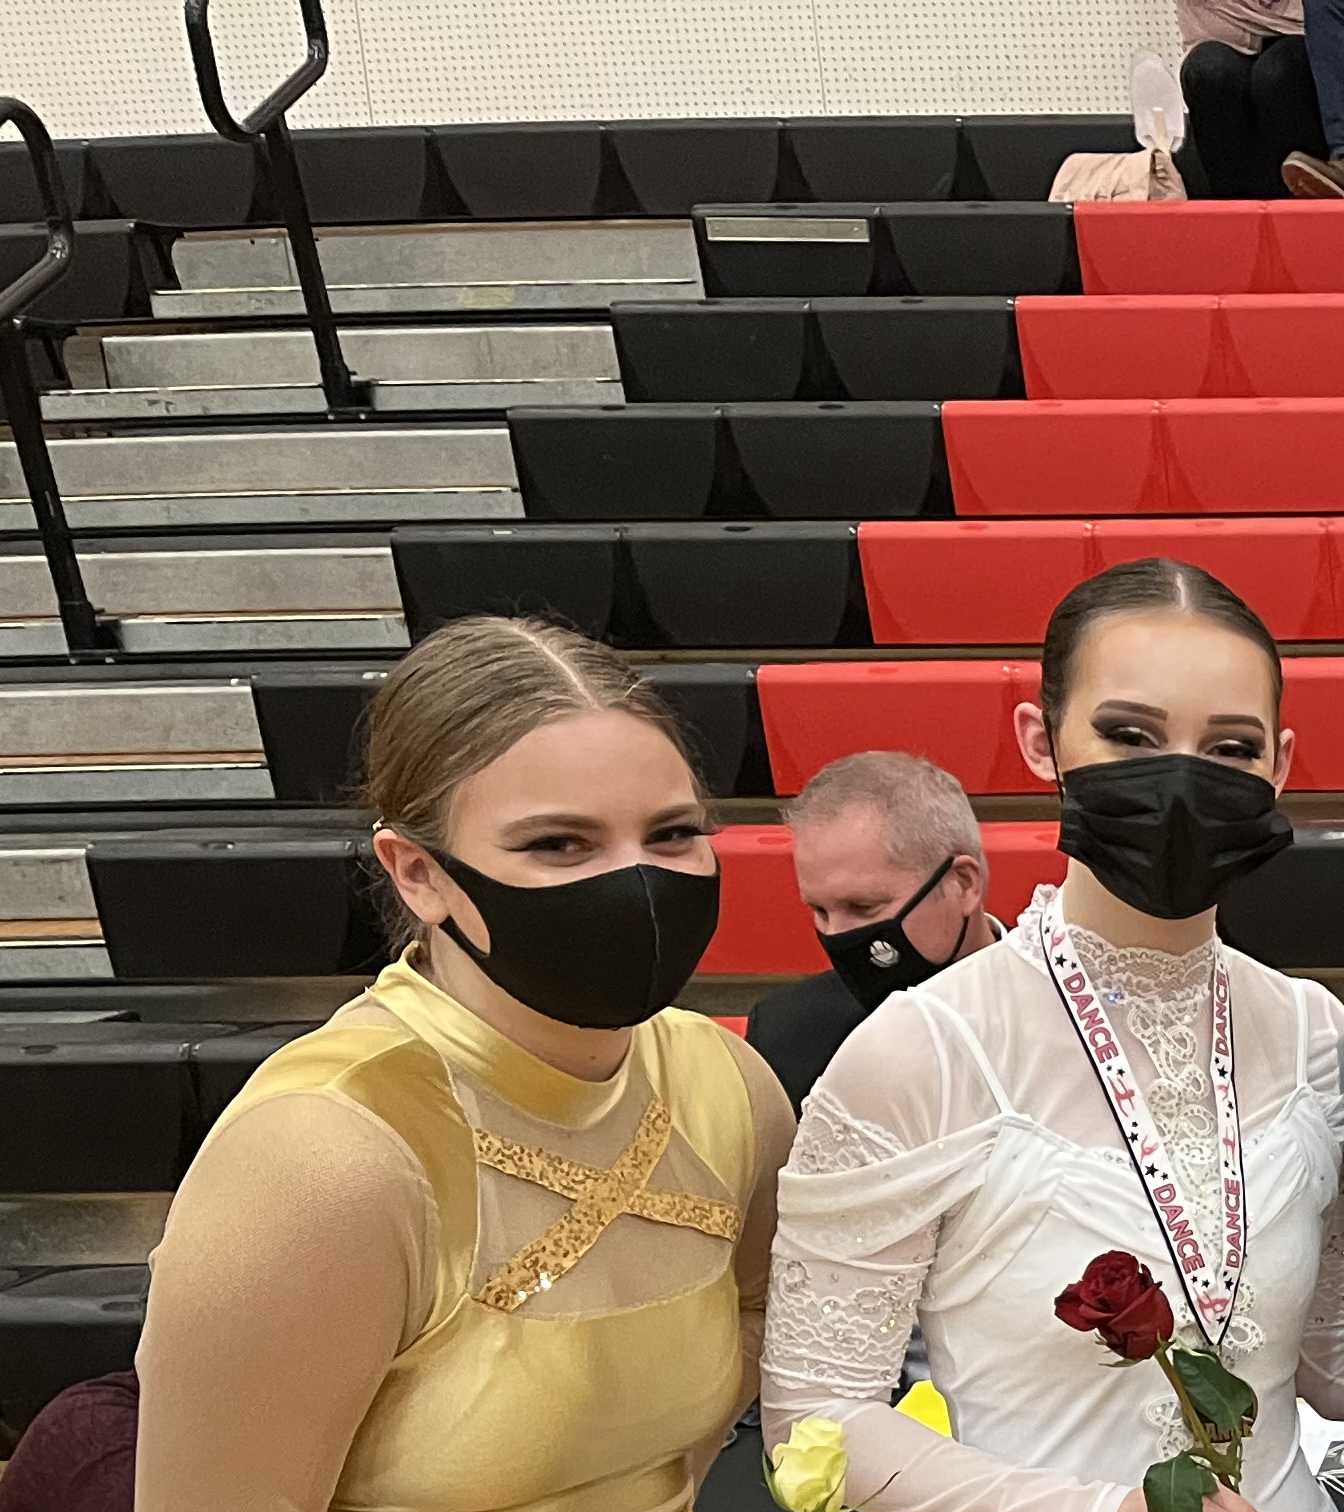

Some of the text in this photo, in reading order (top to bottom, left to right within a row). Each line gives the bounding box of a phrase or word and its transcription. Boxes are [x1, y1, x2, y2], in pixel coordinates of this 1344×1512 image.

[1062, 971, 1119, 1063] DANCE
[1215, 969, 1230, 1057] DANCE
[1153, 1183, 1206, 1275] DANCE
[1224, 1177, 1242, 1269] DANCE
